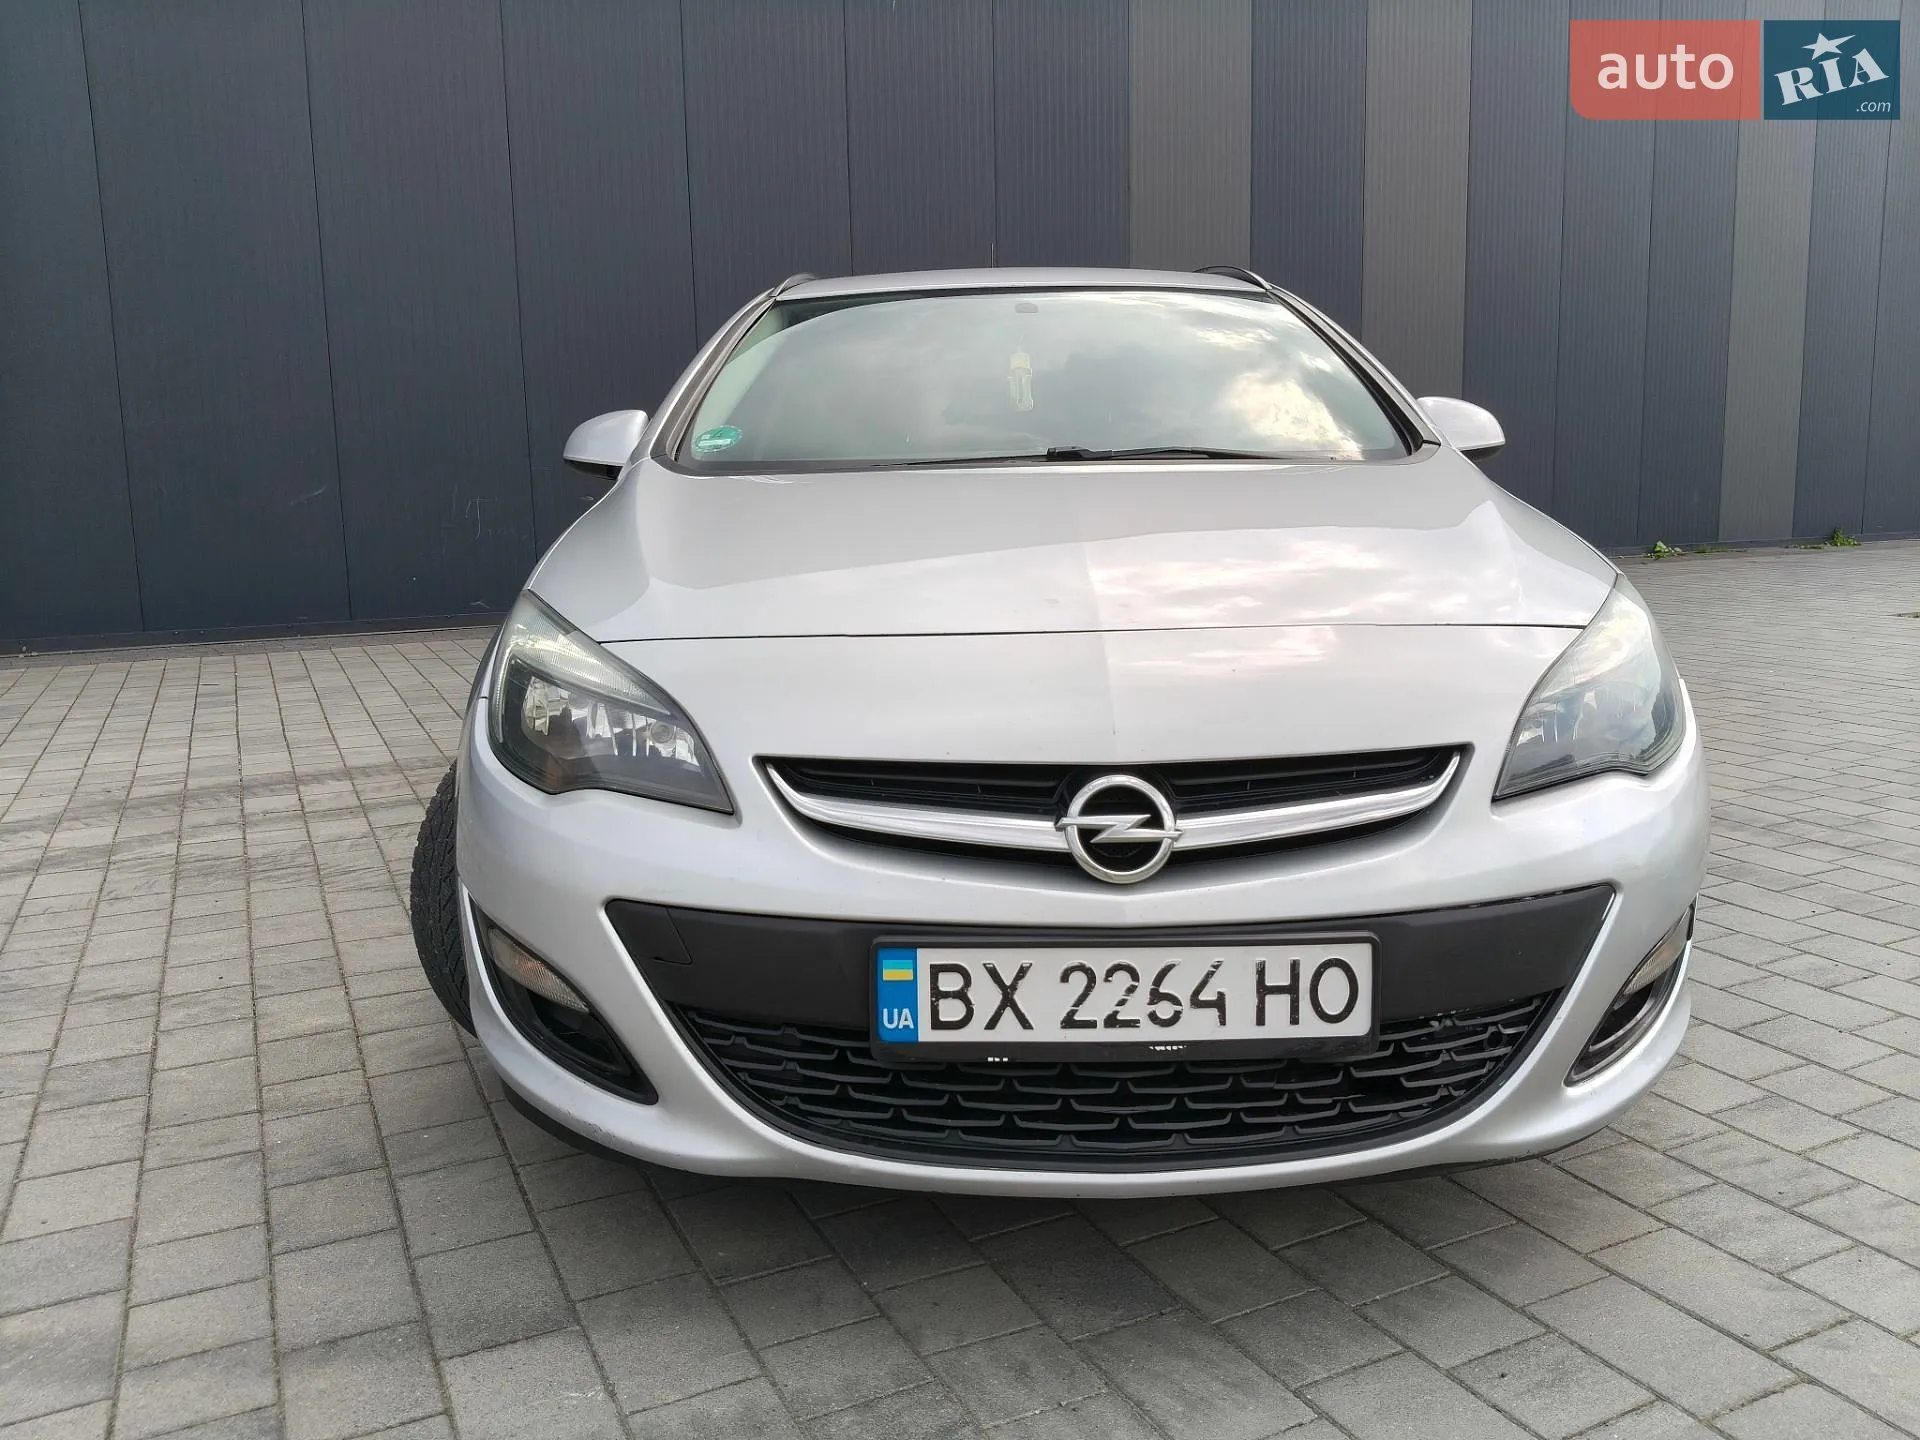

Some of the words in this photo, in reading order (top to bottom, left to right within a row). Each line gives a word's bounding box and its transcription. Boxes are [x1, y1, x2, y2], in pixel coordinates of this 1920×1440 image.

[929, 962, 1034, 1031] BX
[1059, 959, 1227, 1030] 2264
[1255, 957, 1359, 1027] HO
[883, 1008, 914, 1030] UA
